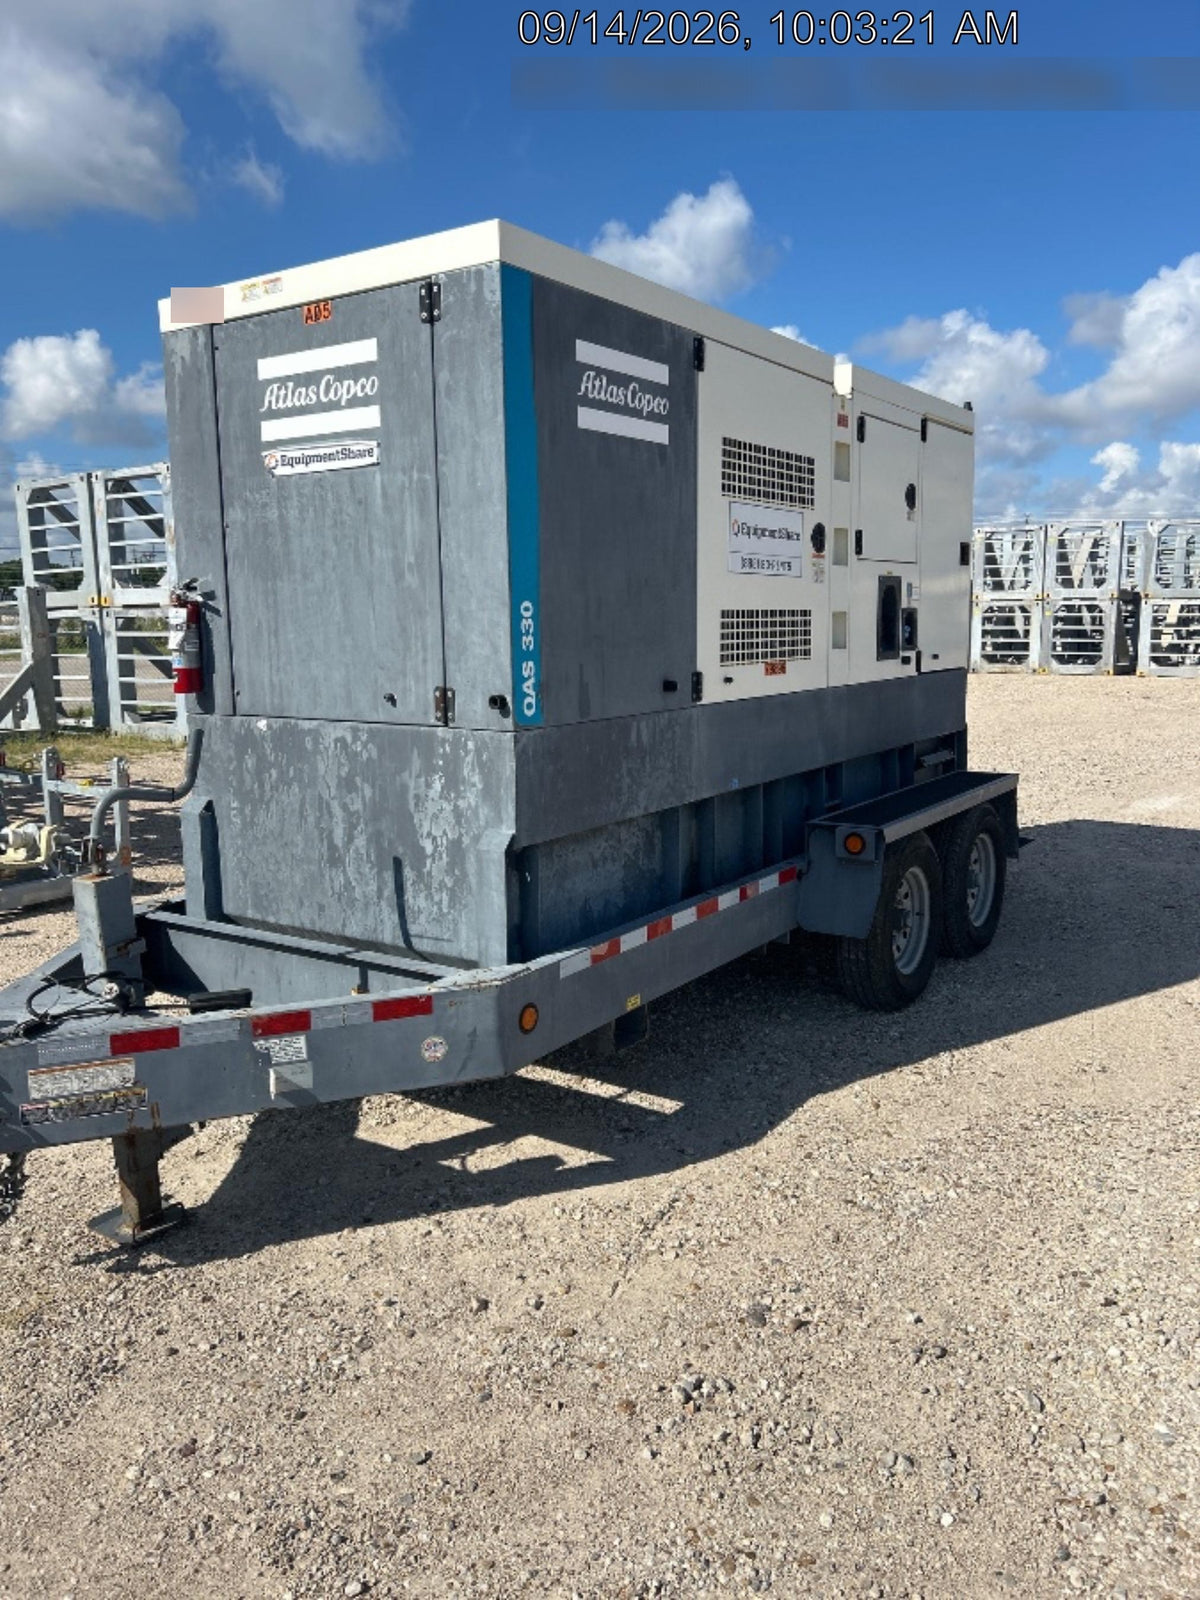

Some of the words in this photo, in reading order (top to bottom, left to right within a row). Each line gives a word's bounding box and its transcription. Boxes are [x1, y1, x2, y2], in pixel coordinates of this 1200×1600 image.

[259, 382, 318, 413] Atlas
[319, 374, 379, 407] Copco
[577, 370, 626, 406] Atlas
[627, 381, 669, 417] Copco
[280, 447, 375, 468] EquipmentShare
[520, 600, 534, 651] 330
[522, 660, 537, 717] QAS
